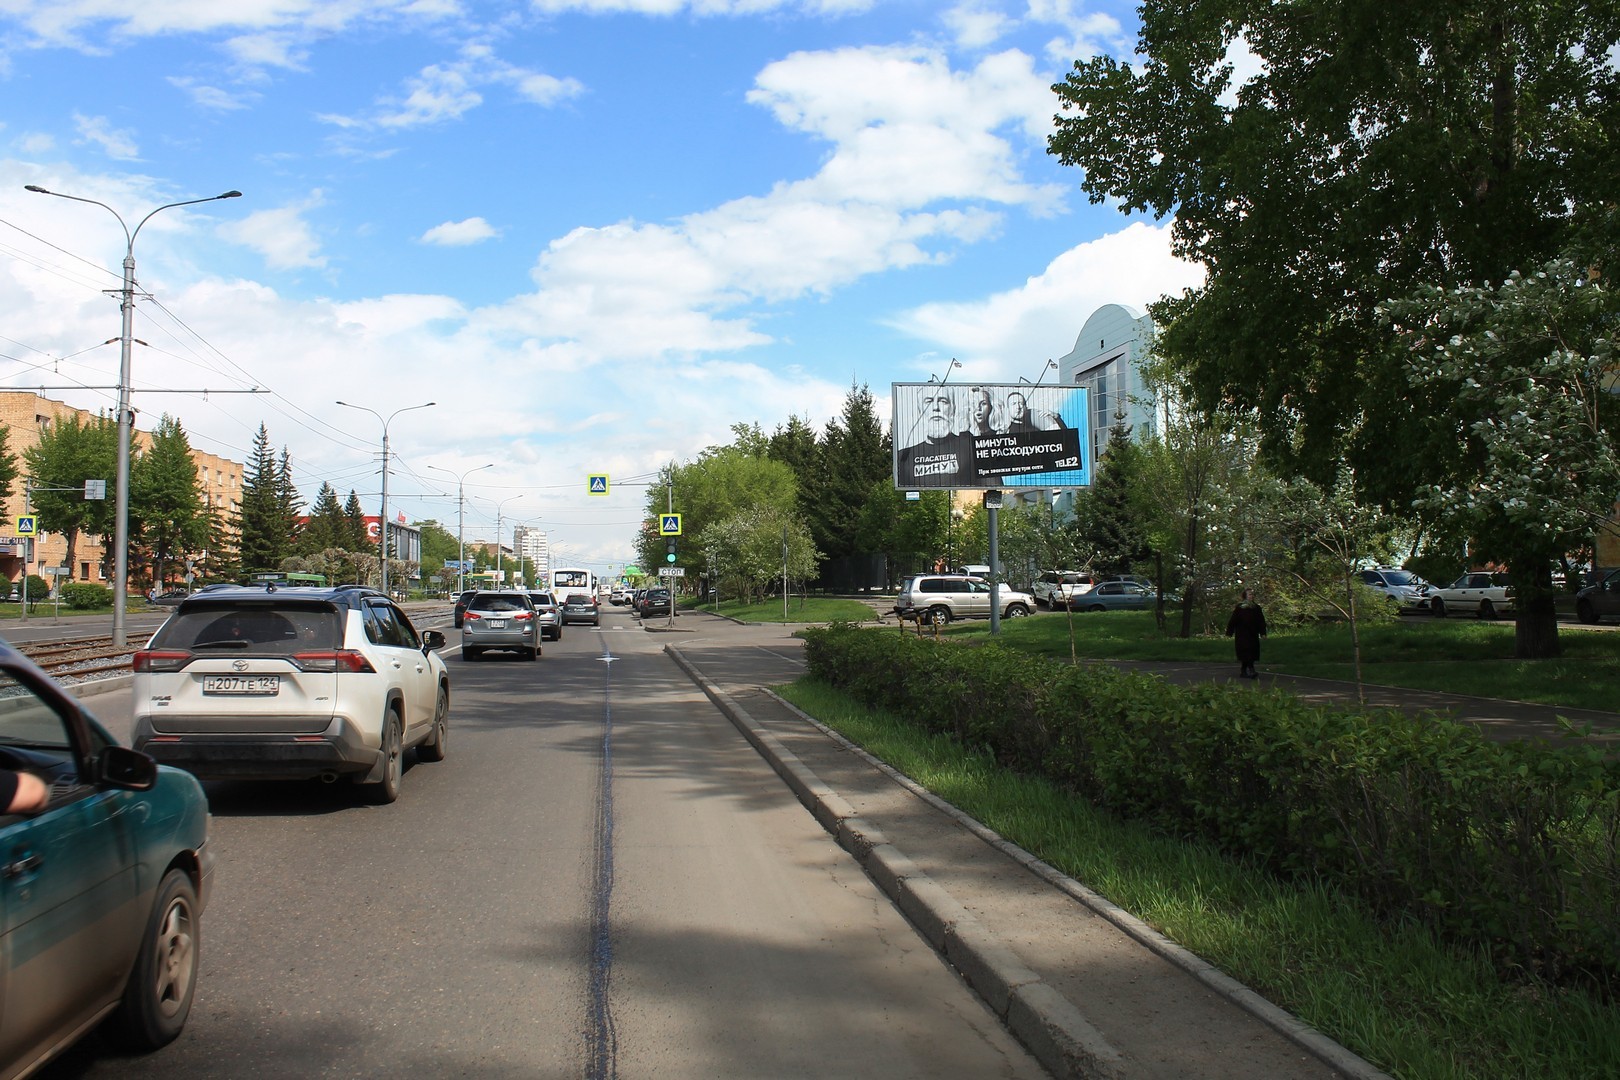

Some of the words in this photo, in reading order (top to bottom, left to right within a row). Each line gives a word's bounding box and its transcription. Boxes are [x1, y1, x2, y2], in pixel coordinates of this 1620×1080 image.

[975, 437, 1017, 449] МИНУТЫ
[976, 449, 990, 459] НЕ
[991, 443, 1063, 458] РАСХОДУЮТСЯ
[914, 453, 956, 463] СПАСАТЕЛИ
[1055, 456, 1079, 468] TELE2
[914, 460, 958, 476] МИНУТ
[258, 677, 275, 687] 124
